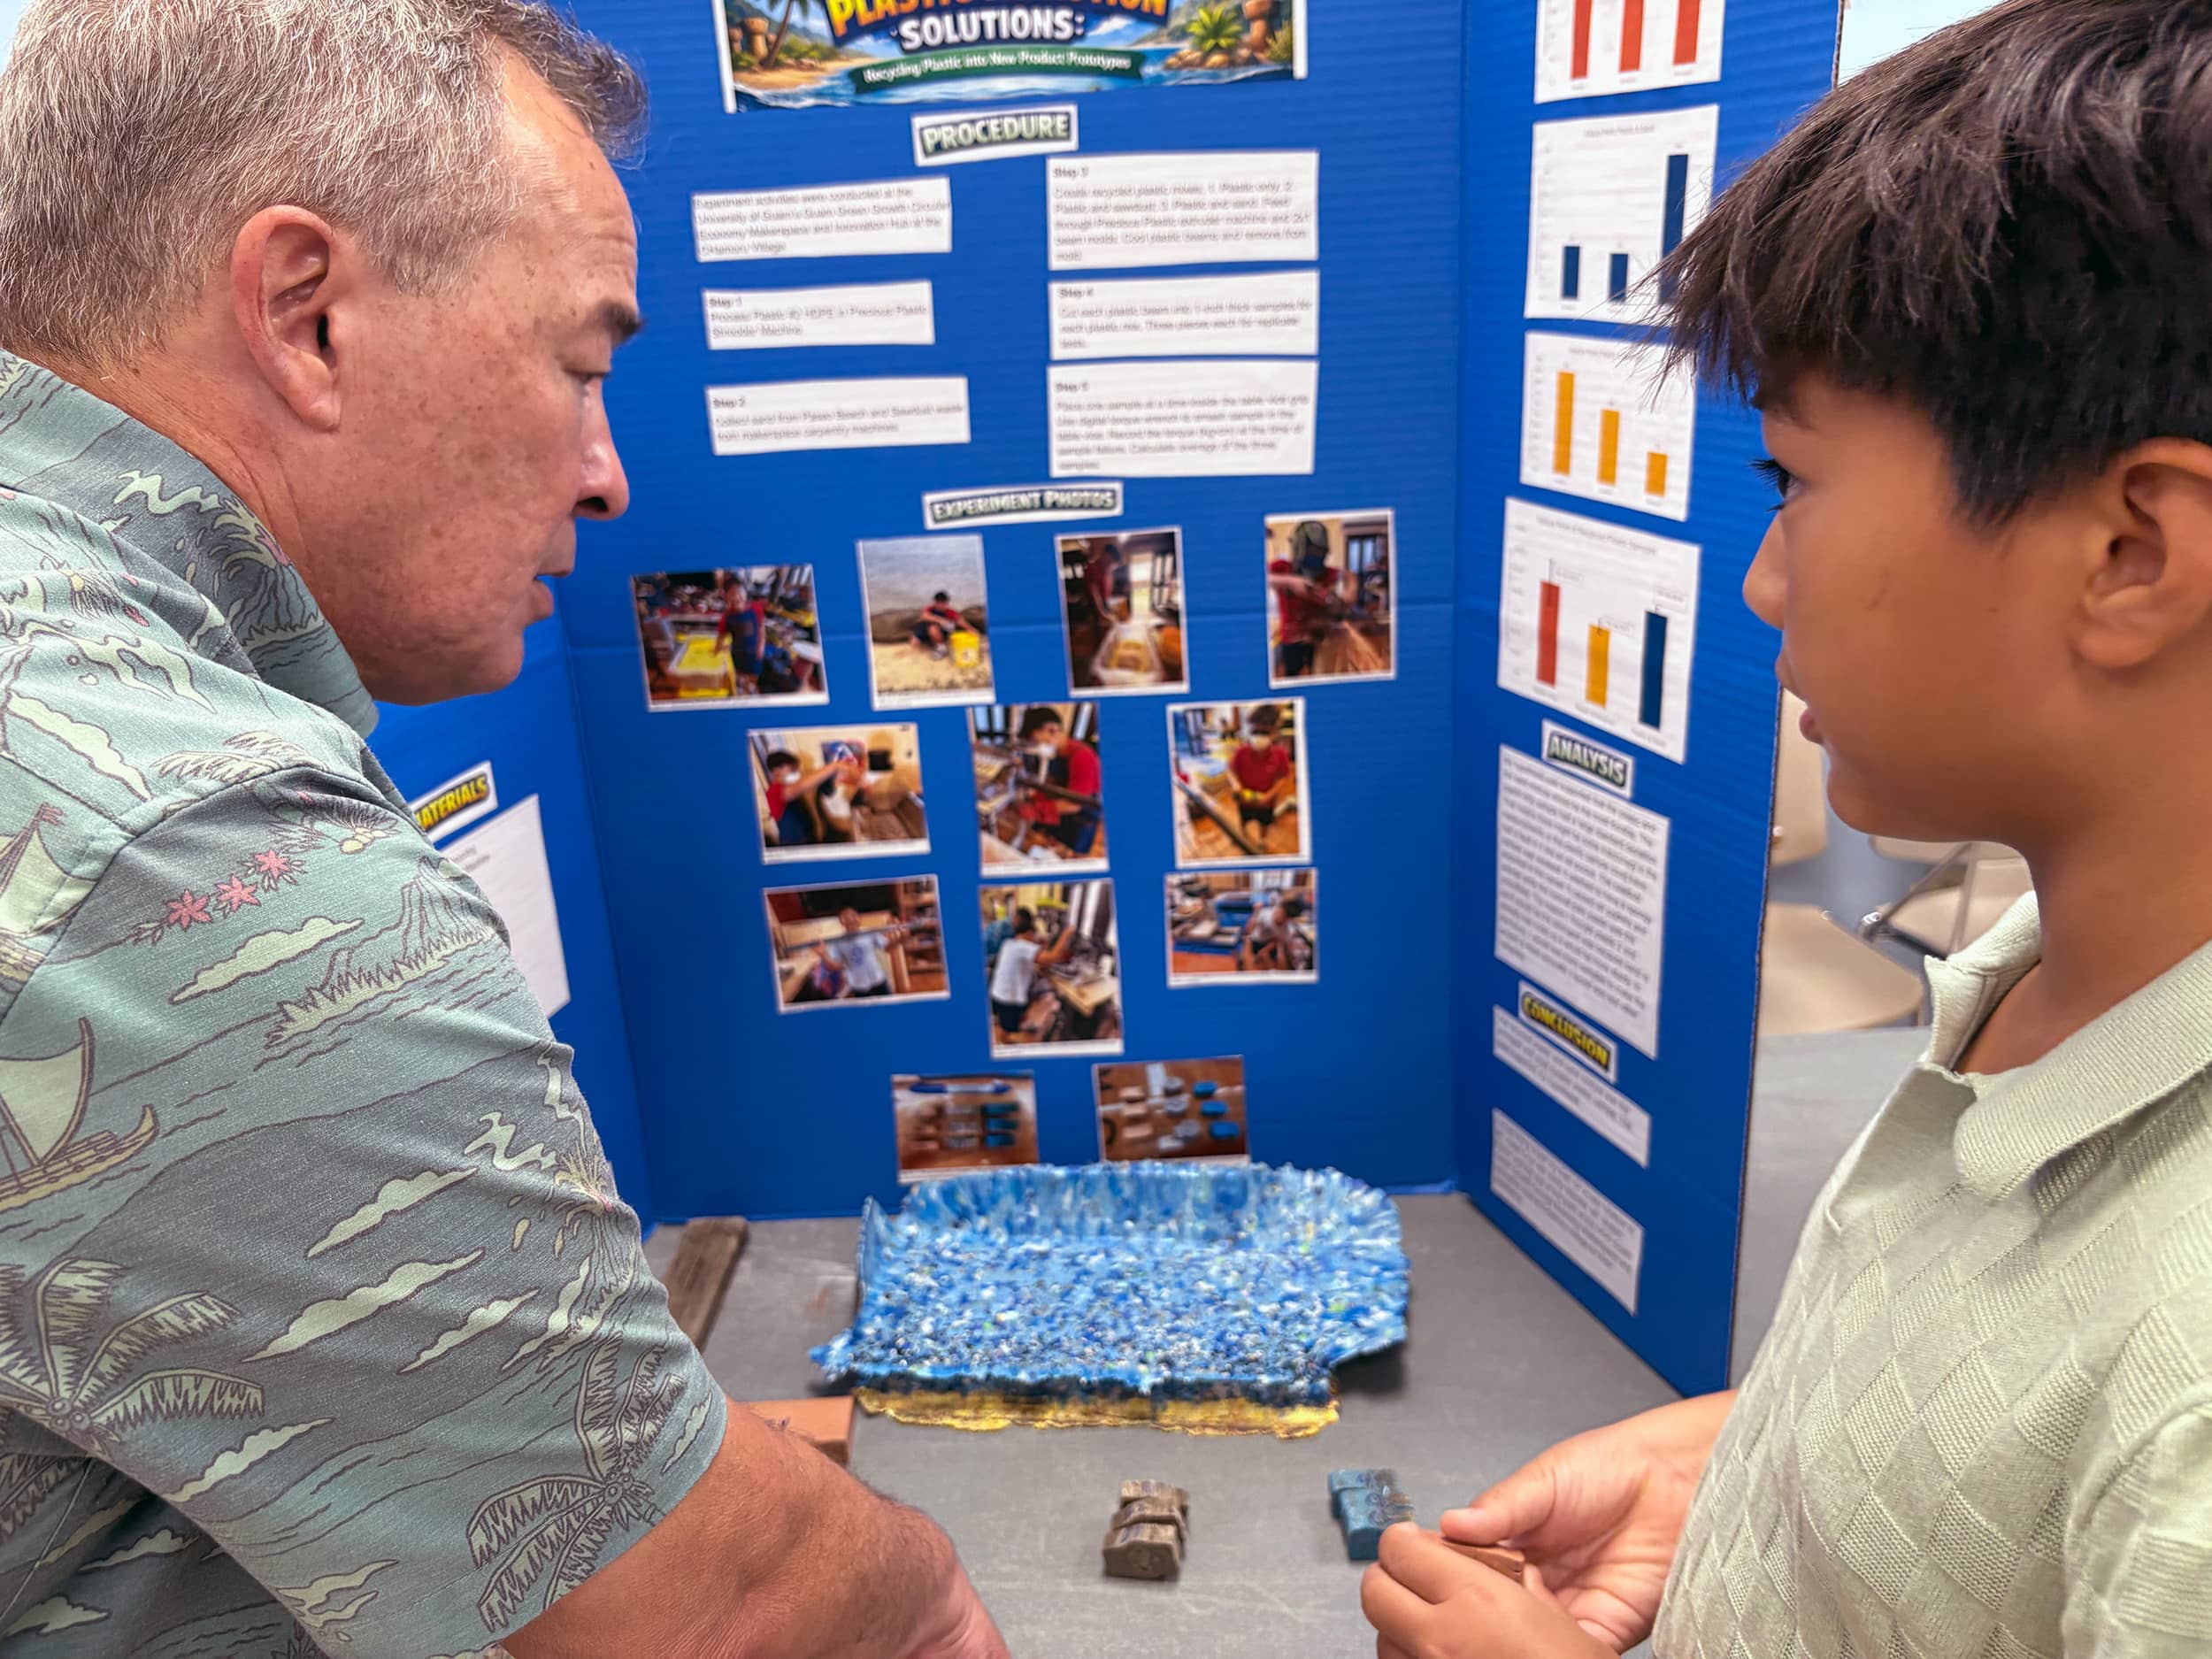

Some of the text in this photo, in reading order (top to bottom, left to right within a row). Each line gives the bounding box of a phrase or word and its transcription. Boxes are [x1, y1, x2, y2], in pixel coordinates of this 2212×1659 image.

[898, 8, 1085, 50] SOLUTIONS:
[922, 56, 963, 73] Plastic
[923, 112, 1070, 153] PROCEDURE
[933, 489, 1115, 521] EXPERIMENT PHOTOS
[1549, 734, 1625, 785] ANALYSIS
[1523, 996, 1609, 1068] CONCLUSION
